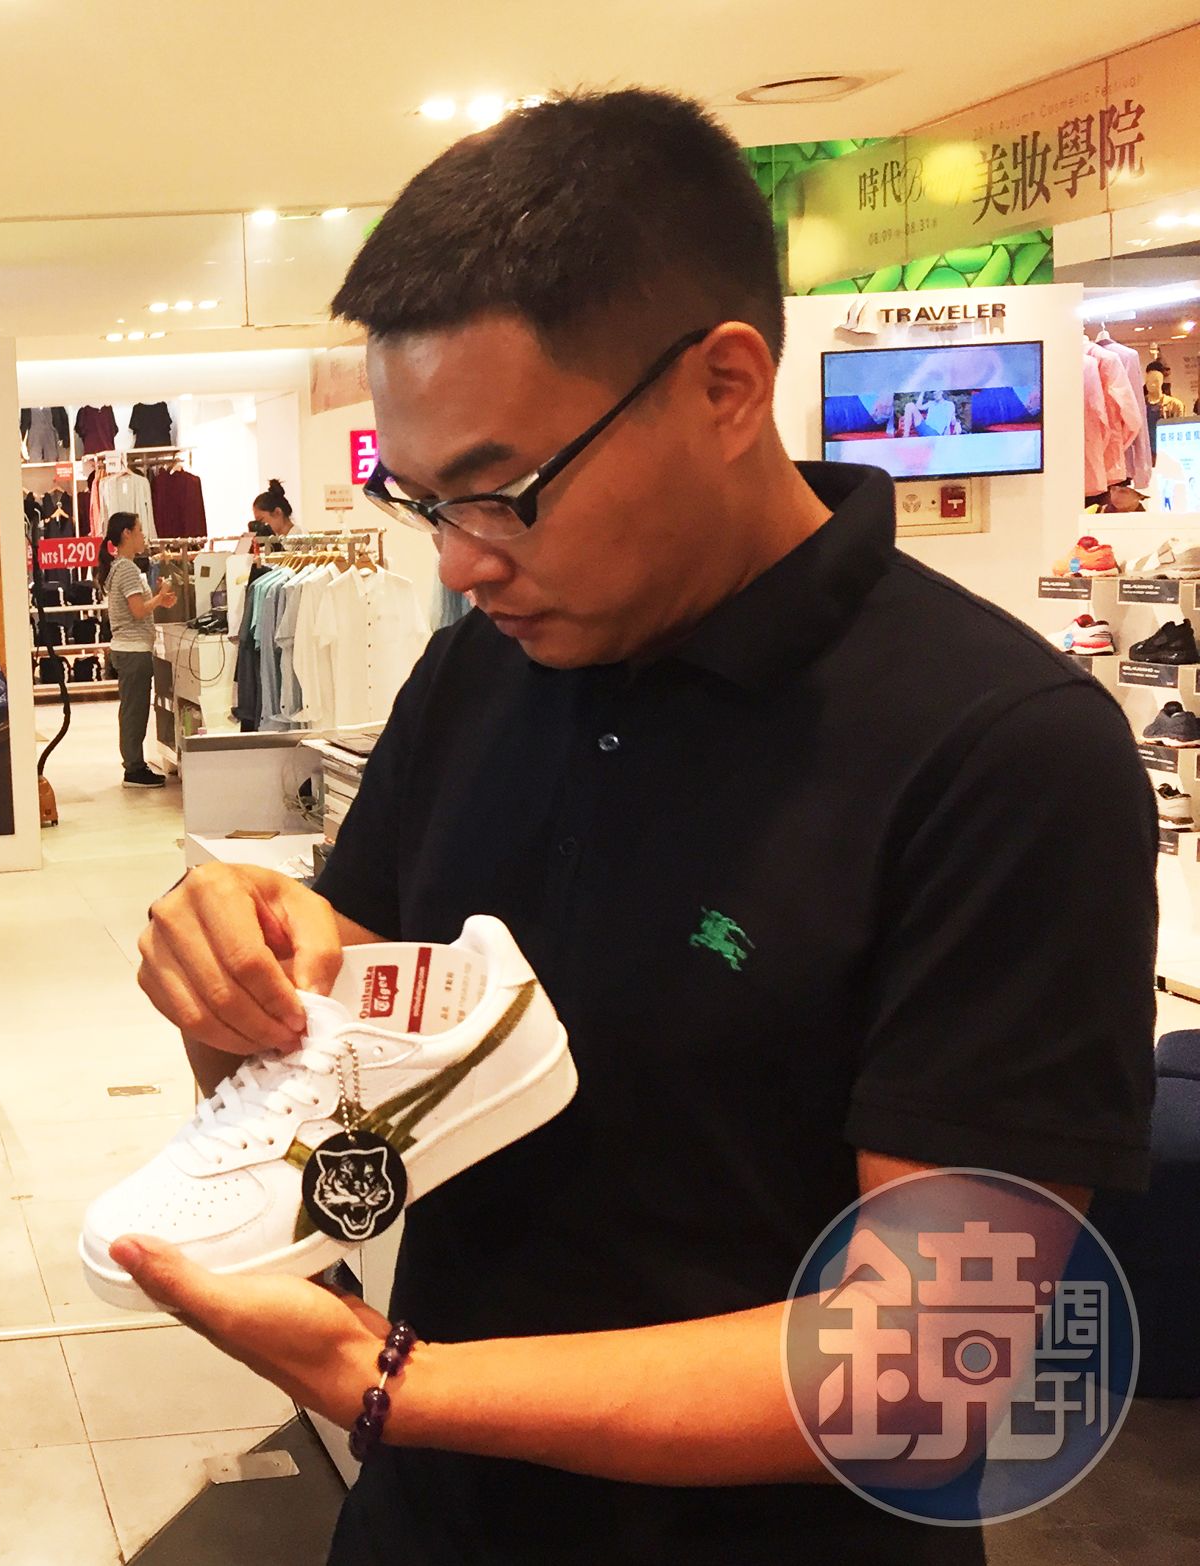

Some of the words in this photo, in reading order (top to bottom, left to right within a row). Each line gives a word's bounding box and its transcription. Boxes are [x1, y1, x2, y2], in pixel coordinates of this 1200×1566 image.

[858, 160, 902, 211] 時代
[973, 99, 1146, 224] 美妝學院
[880, 303, 1006, 323] TRAVELER
[41, 542, 96, 566] NT$1,290
[359, 965, 375, 1020] Onitsuka
[373, 971, 391, 1013] Tiger
